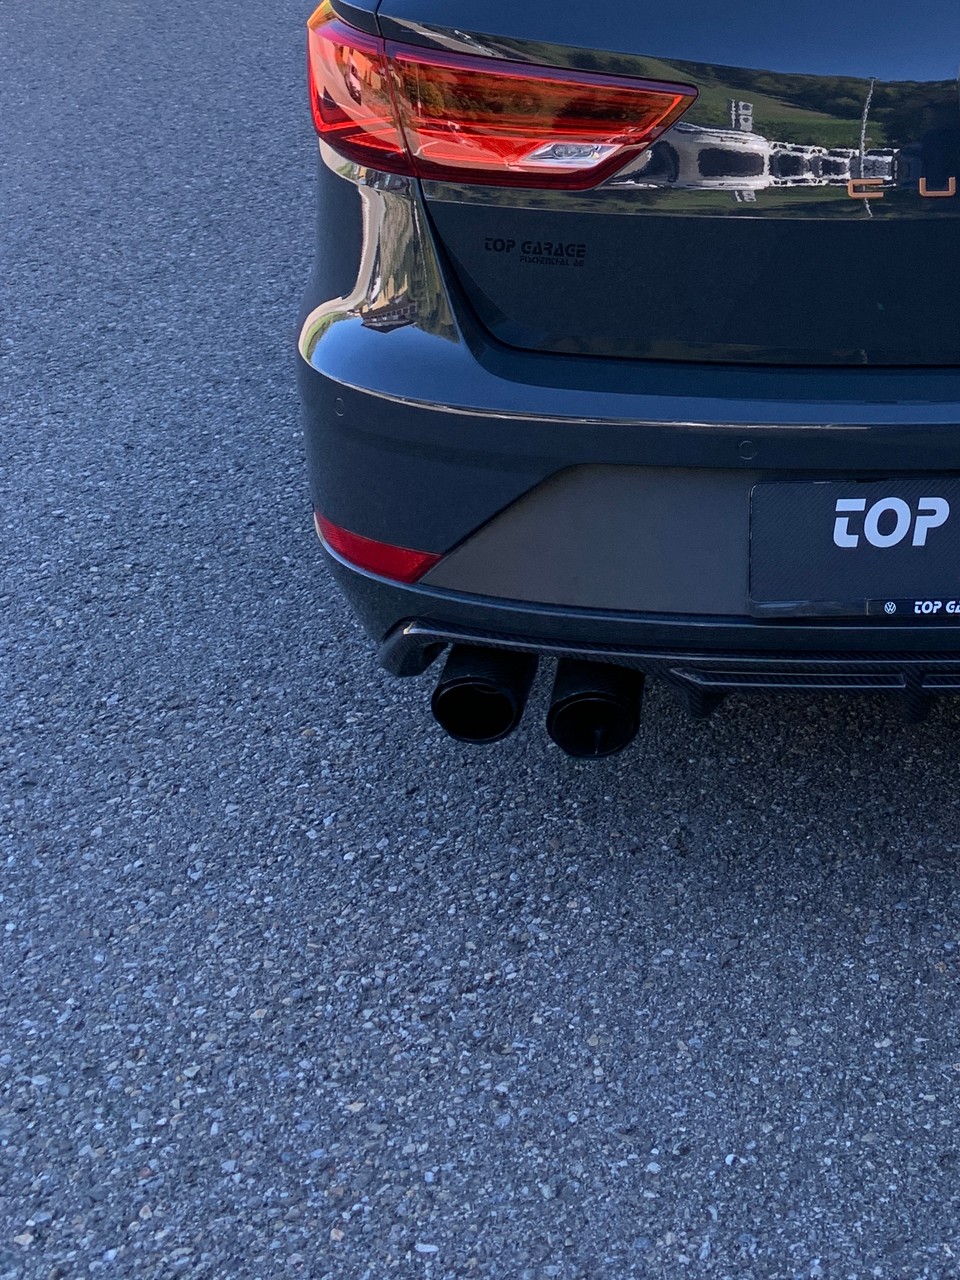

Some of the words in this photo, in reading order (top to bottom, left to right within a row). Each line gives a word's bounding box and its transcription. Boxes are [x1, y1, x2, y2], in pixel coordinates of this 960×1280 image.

[484, 237, 516, 253] TOP
[520, 240, 587, 258] GARAGE
[833, 496, 950, 548] TOP
[914, 601, 943, 614] TOP
